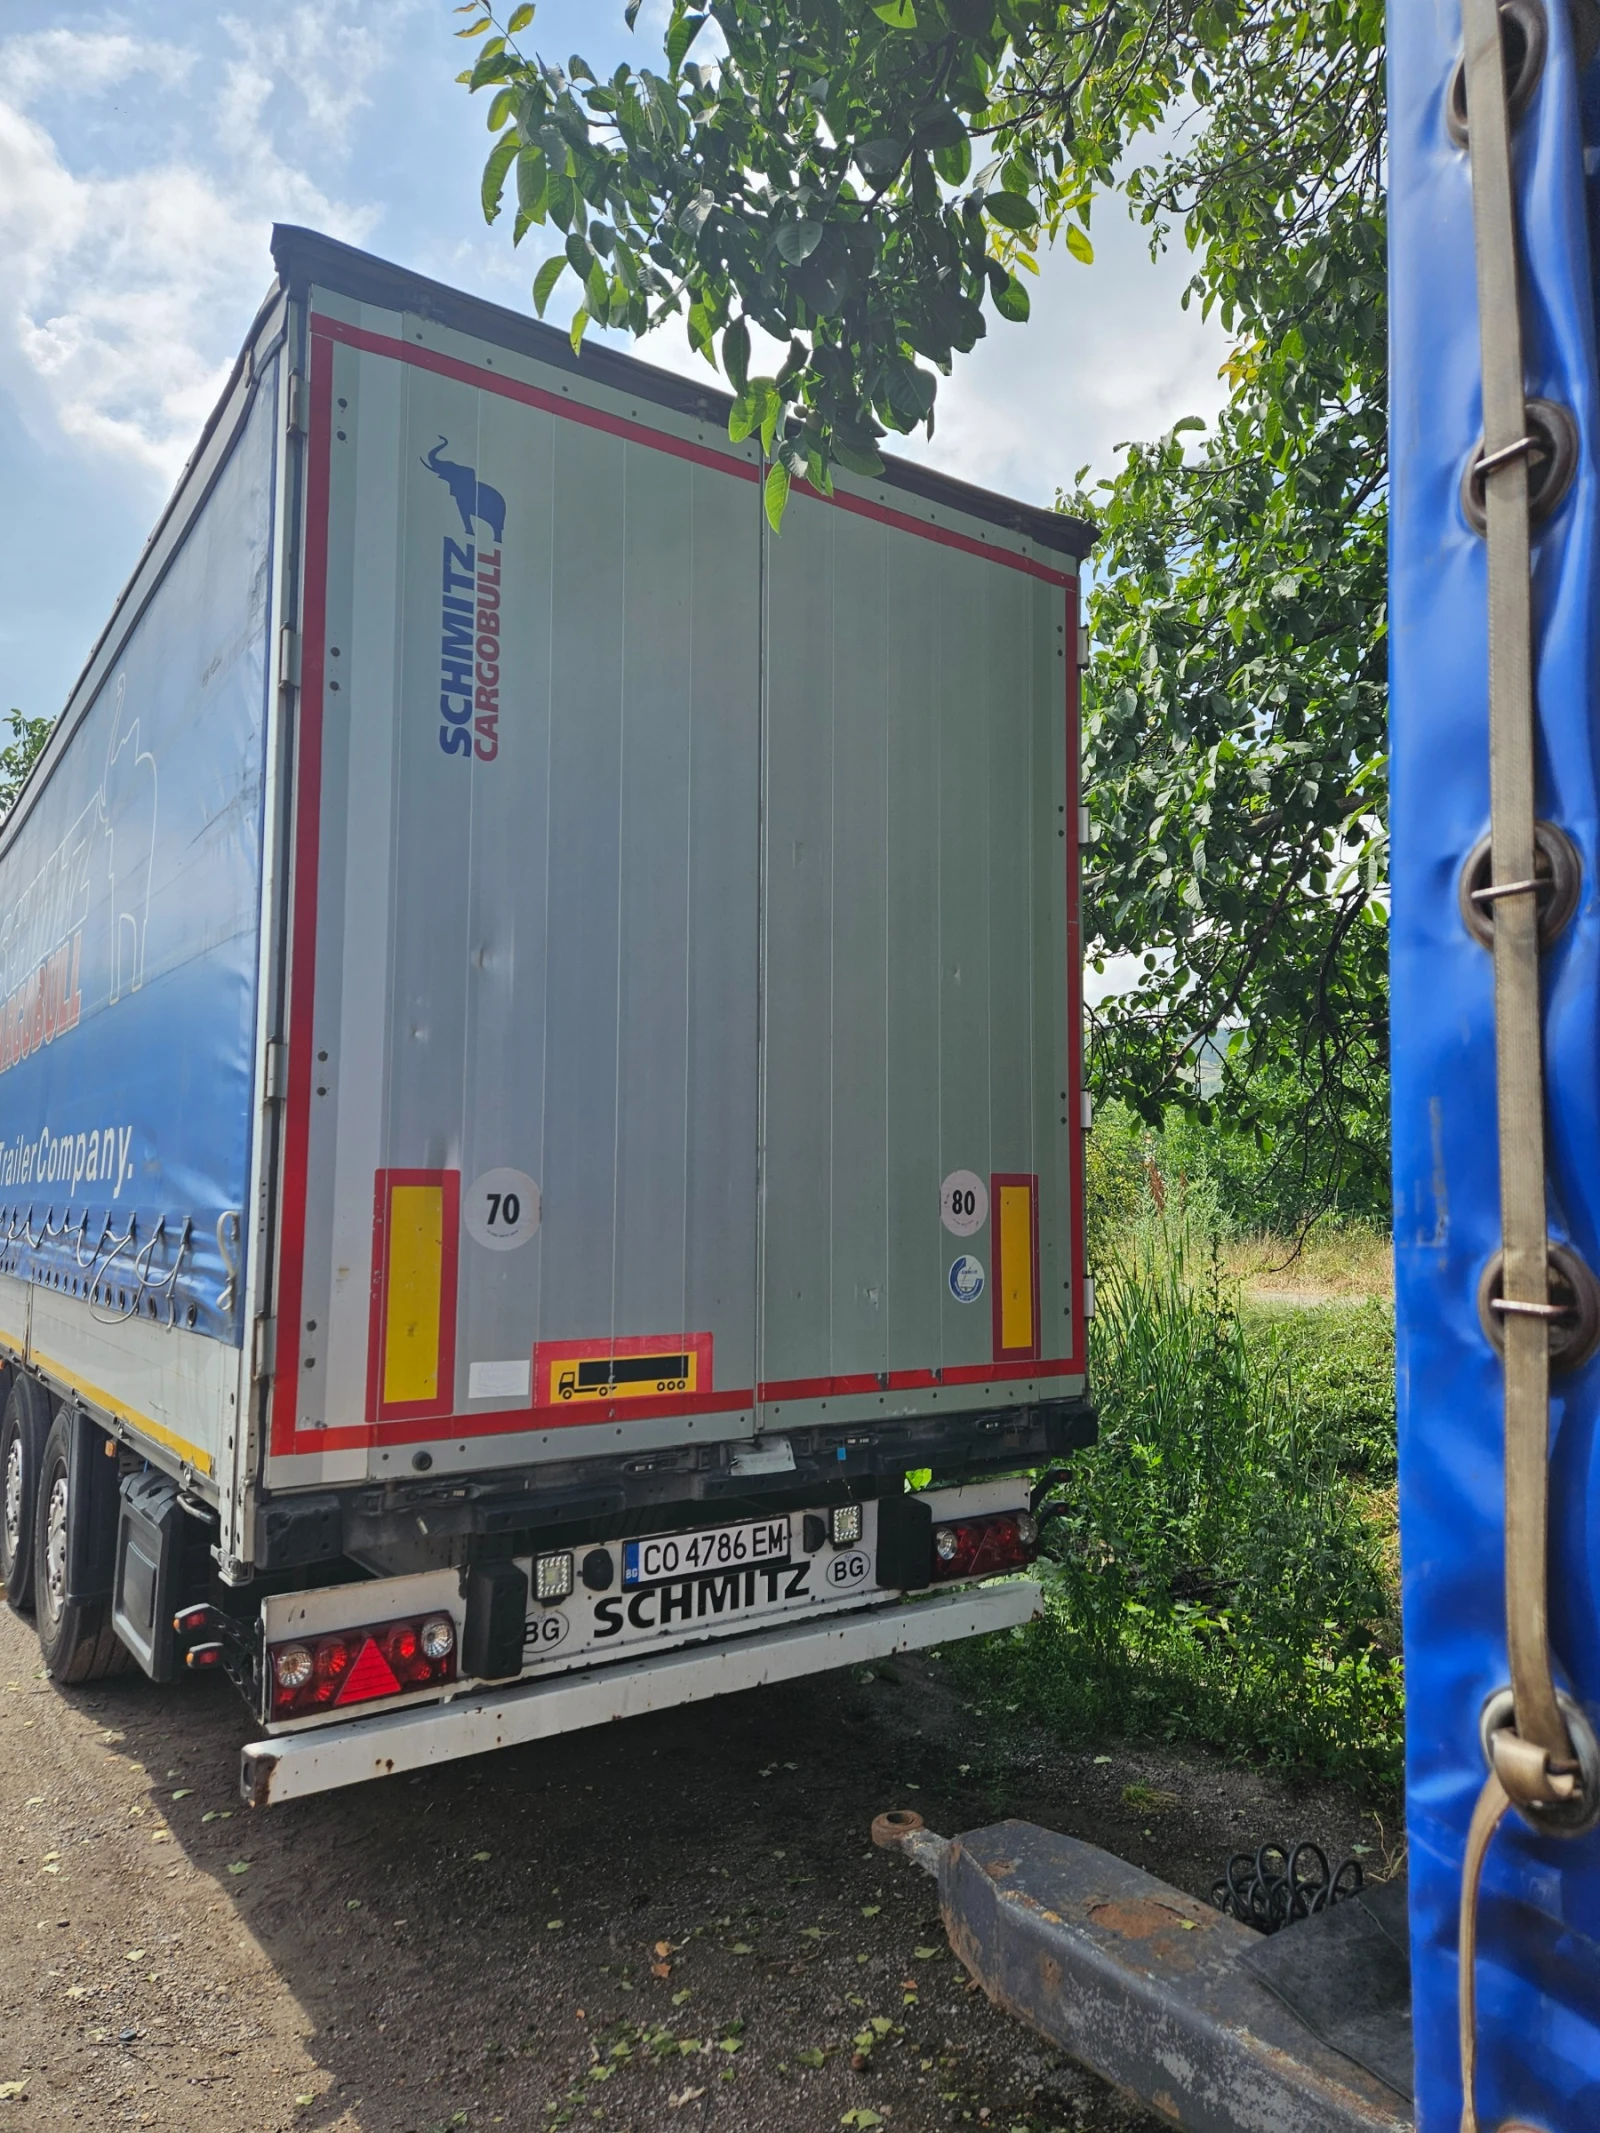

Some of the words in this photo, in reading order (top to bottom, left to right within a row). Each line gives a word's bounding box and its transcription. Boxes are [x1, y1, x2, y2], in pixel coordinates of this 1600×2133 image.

[438, 535, 476, 757] SCHMITZ
[474, 548, 501, 762] CARGOBULL
[486, 1193, 520, 1225] 70
[952, 1189, 976, 1216] 80
[625, 1567, 638, 1579] BG
[834, 1556, 864, 1582] BG
[593, 1561, 811, 1639] SCHMITZ
[523, 1617, 560, 1645] BG
